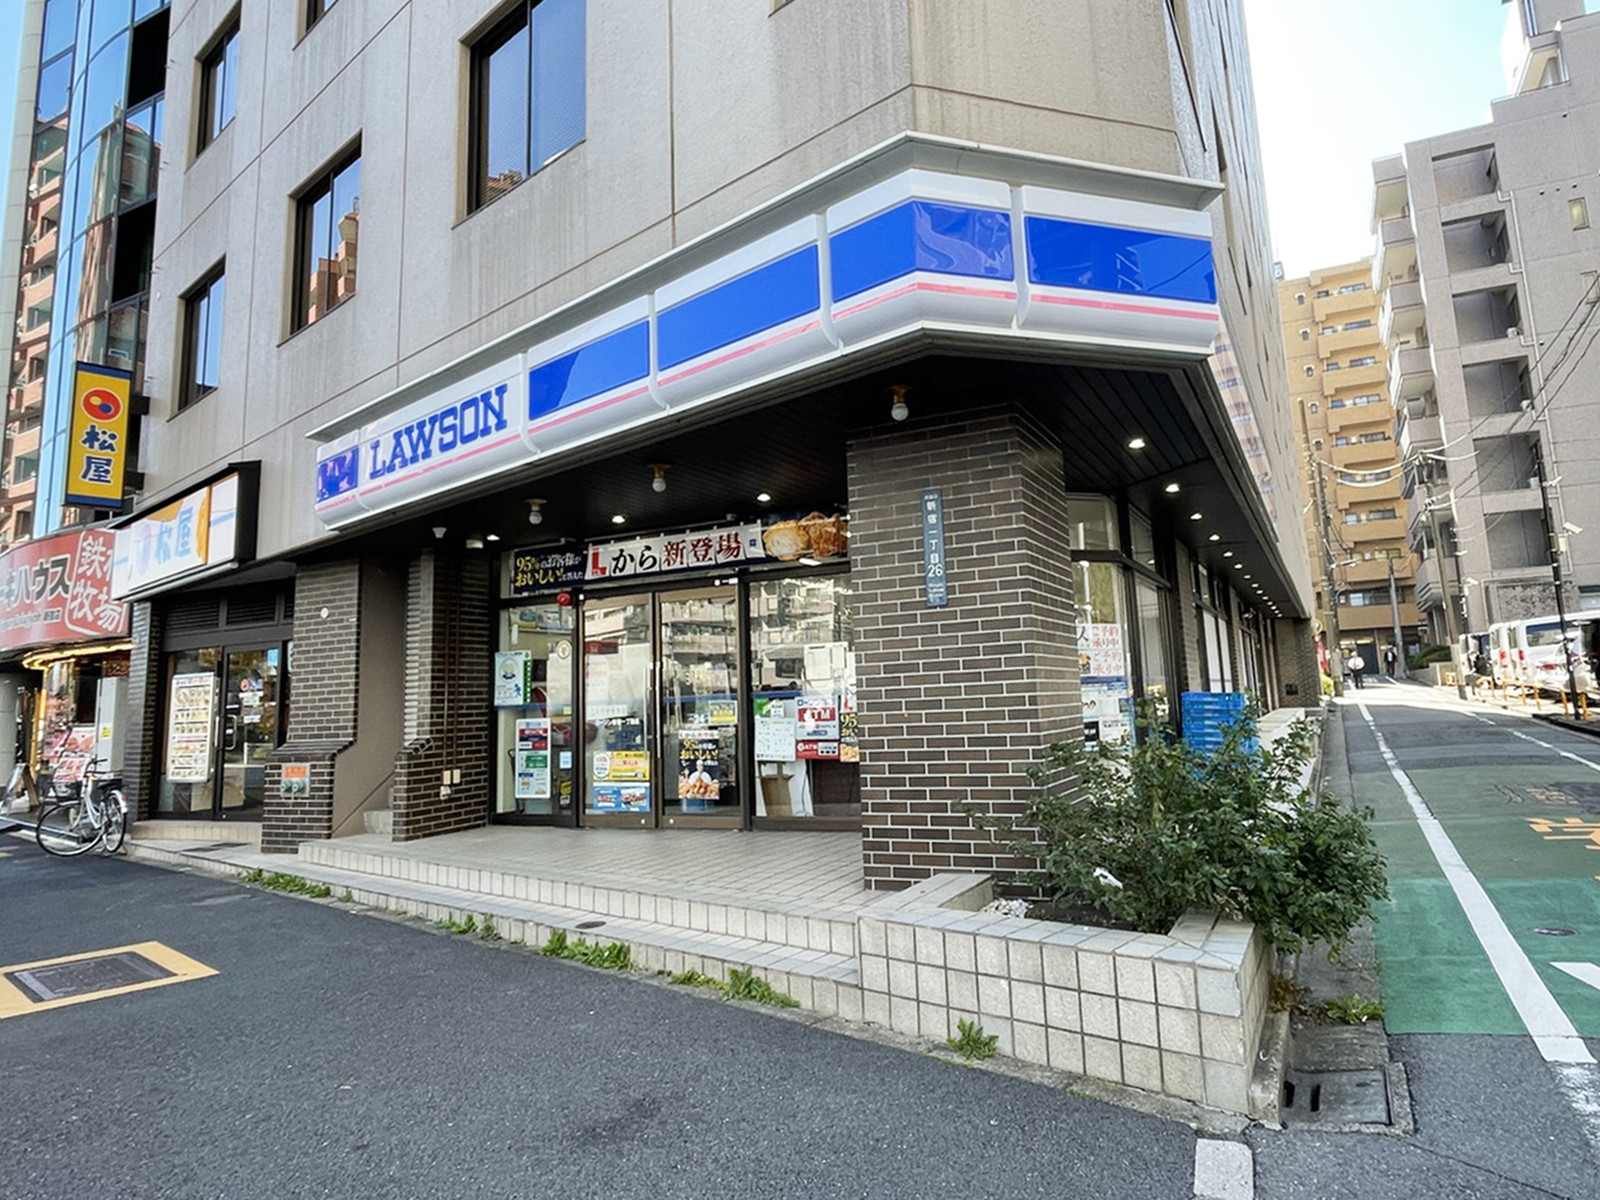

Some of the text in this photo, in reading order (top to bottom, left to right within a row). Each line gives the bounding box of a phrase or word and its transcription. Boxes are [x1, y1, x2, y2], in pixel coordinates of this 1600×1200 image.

[80, 424, 118, 485] 松屋
[368, 383, 509, 480] LAWSON
[927, 565, 943, 577] 26
